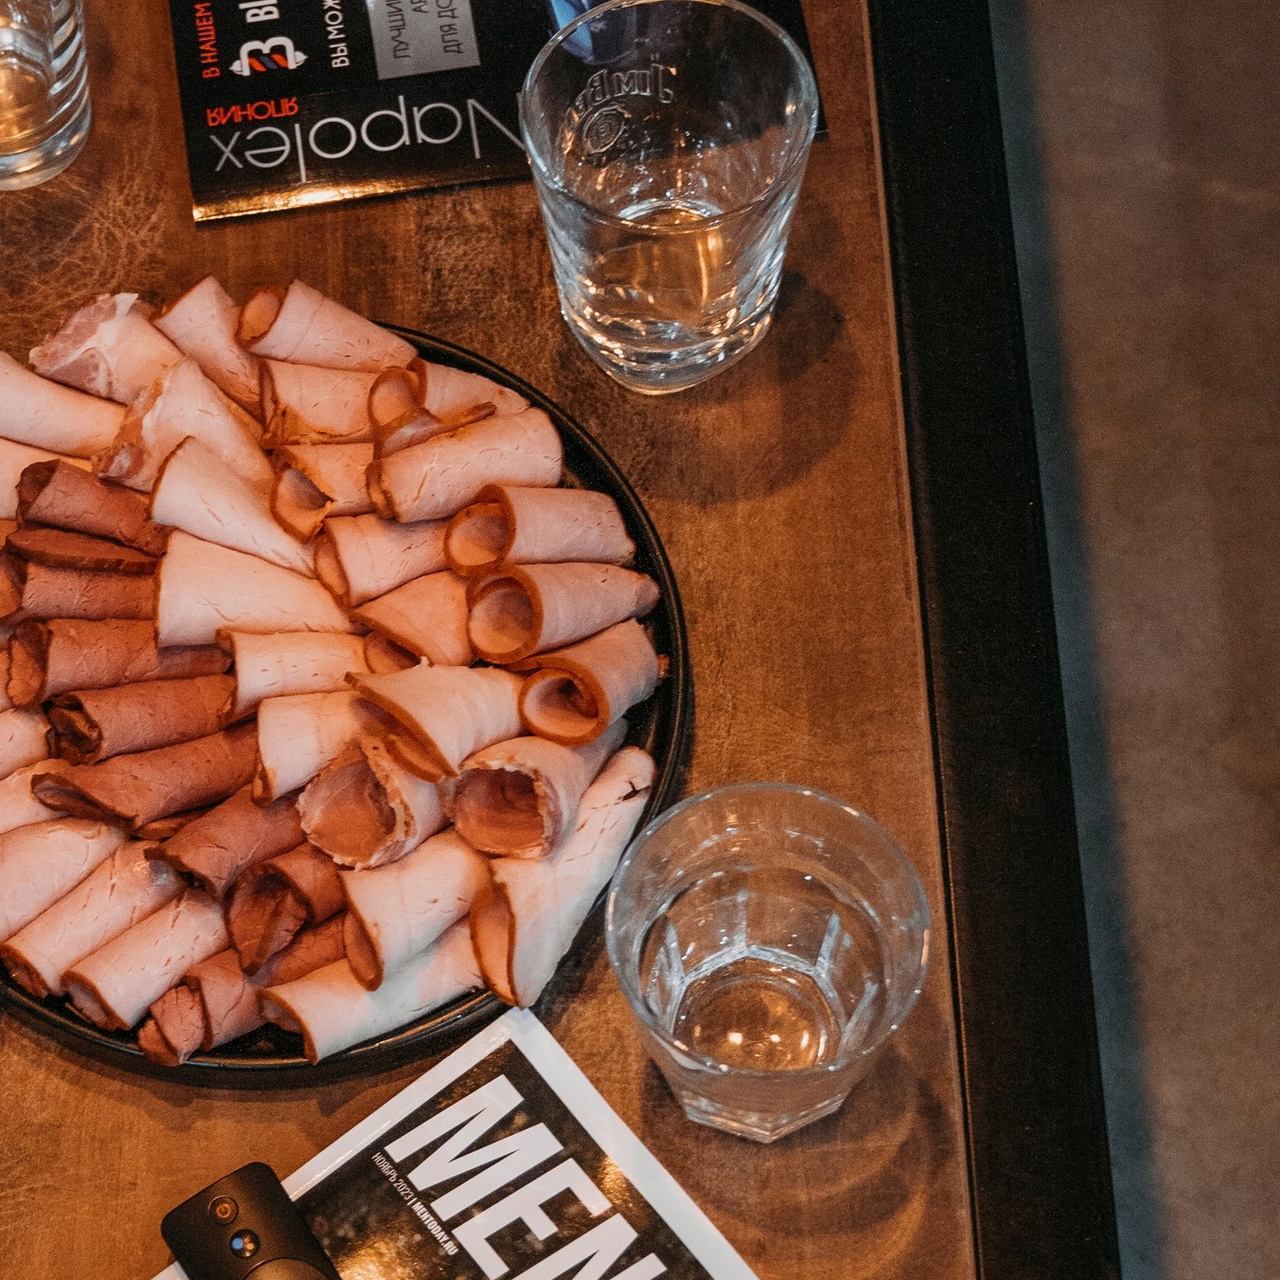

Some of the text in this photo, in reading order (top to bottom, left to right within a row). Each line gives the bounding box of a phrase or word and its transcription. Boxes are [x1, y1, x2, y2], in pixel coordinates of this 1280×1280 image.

[193, 1, 219, 65] НАШЕМ
[440, 24, 464, 55] ДЛЯ
[331, 45, 350, 68] ВЫ
[202, 68, 220, 78] В
[206, 97, 299, 126] ЯПОНИЯ
[210, 95, 525, 184] Napolex
[369, 1150, 462, 1257] НОЯБРЬ 2023 MENTODAY.RU
